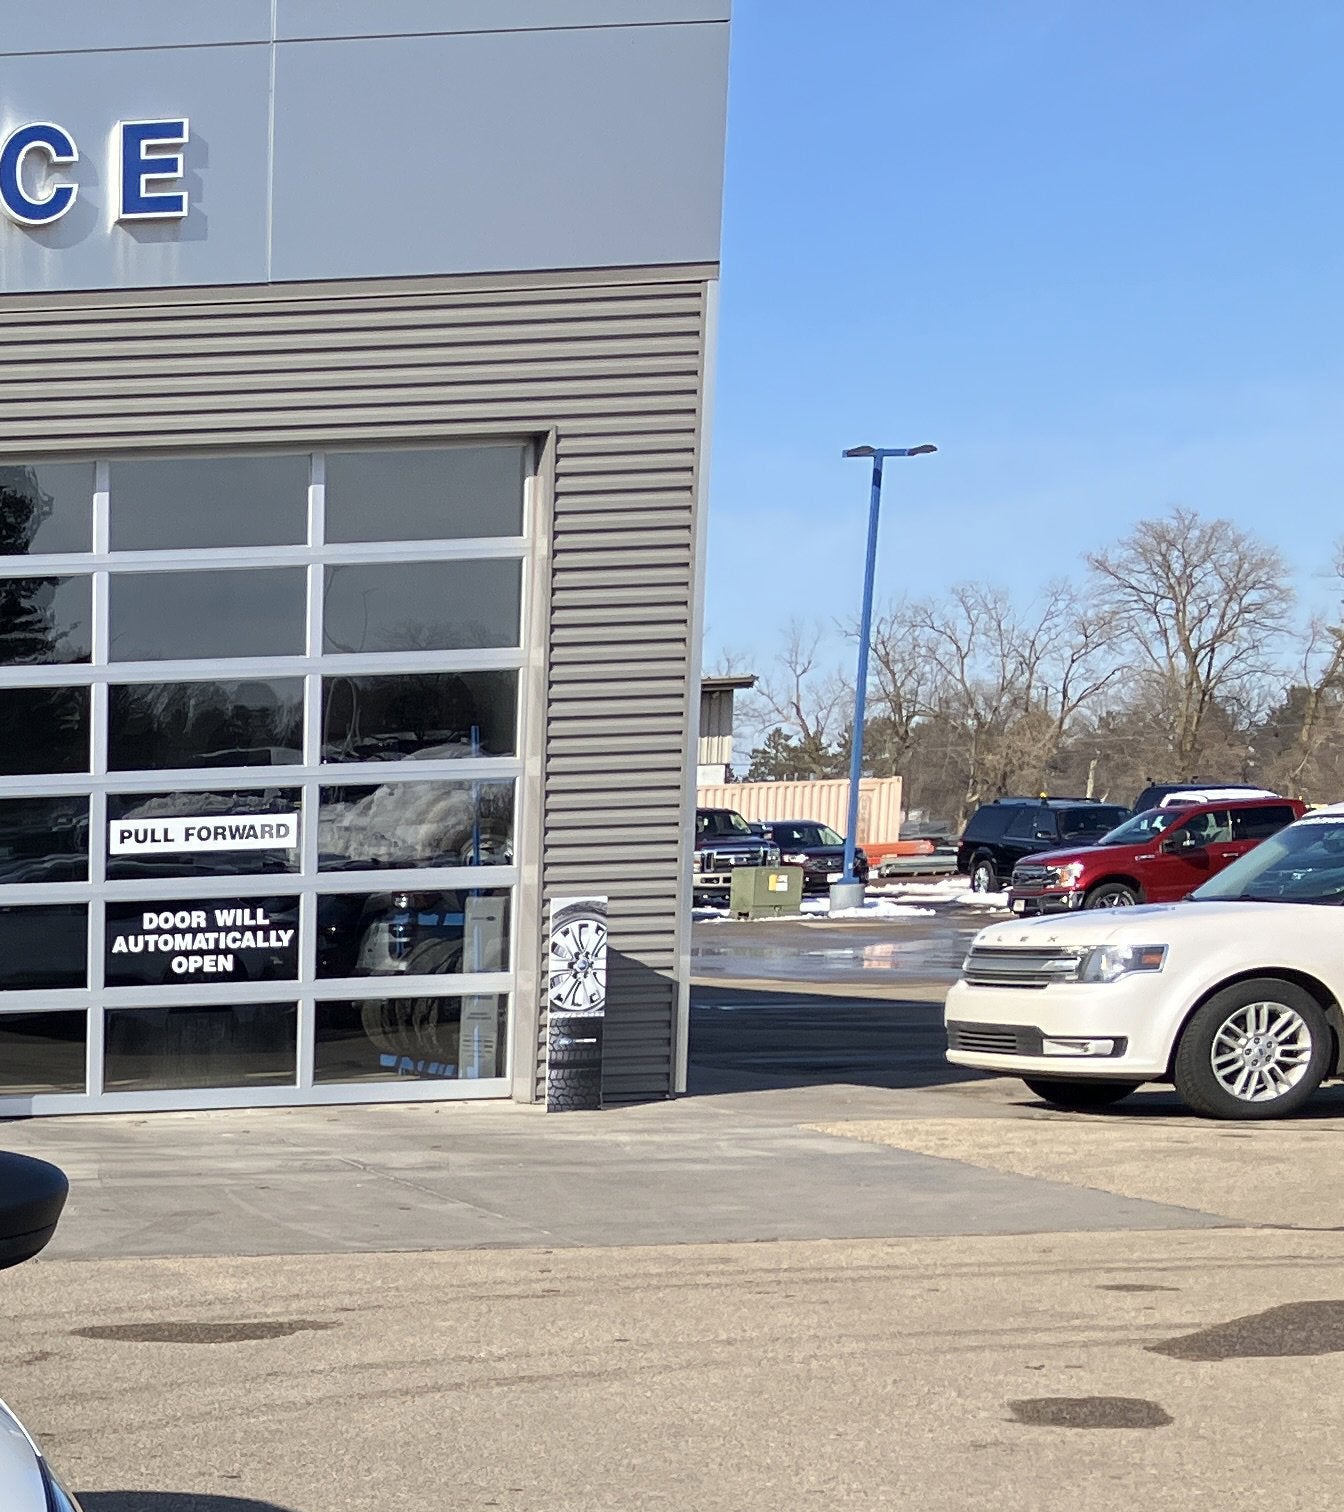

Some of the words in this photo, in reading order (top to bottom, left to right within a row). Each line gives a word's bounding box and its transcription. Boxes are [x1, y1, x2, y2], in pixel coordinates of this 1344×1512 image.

[119, 827, 175, 845] PULL
[184, 823, 290, 842] FORWARD
[143, 911, 206, 930] DOOR
[215, 908, 270, 927] WILL
[112, 929, 294, 953] AUTOMATICALLY
[171, 954, 234, 974] OPEN
